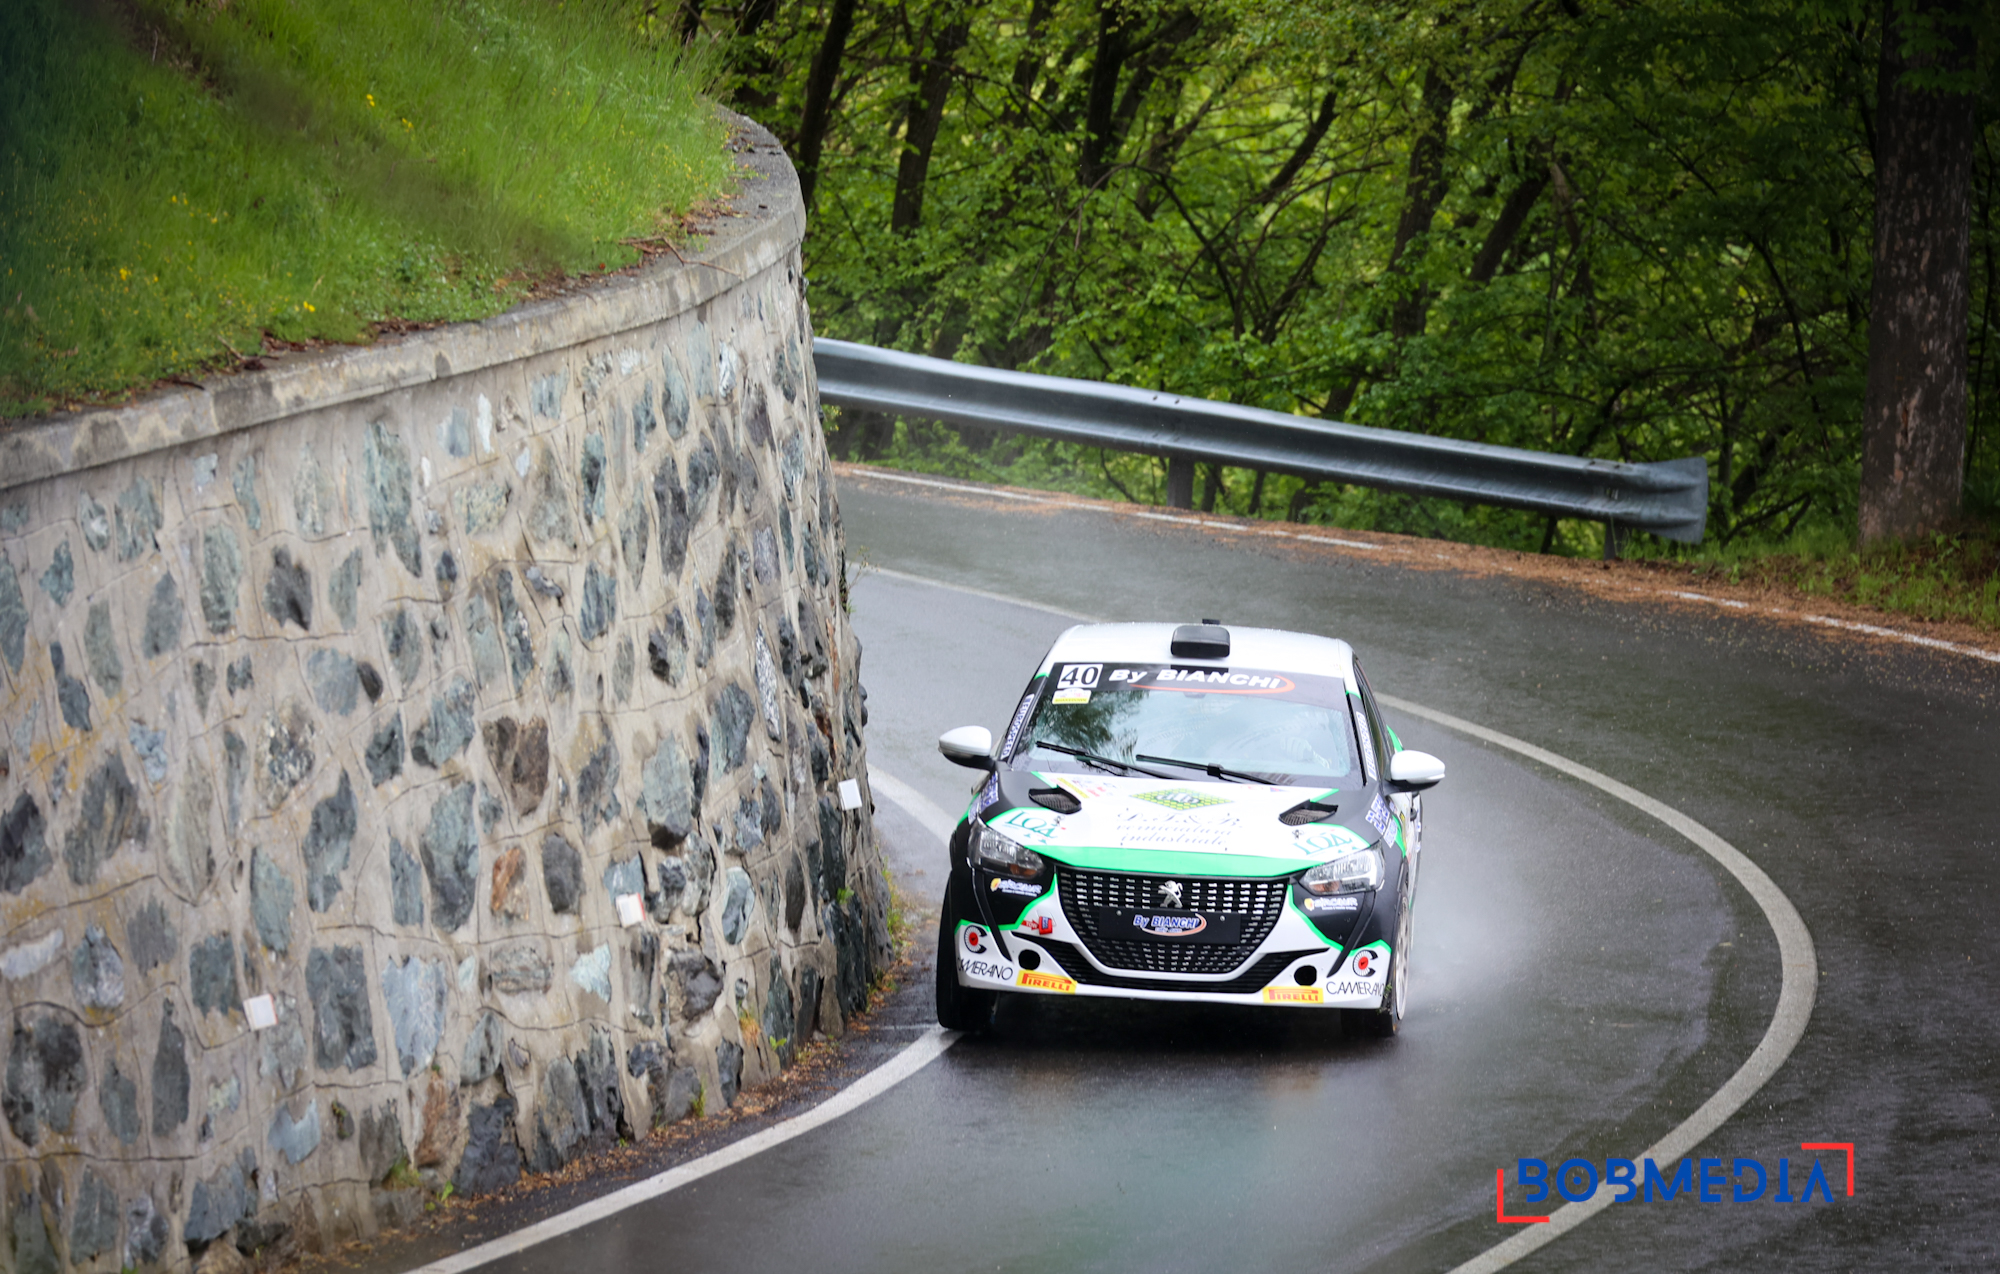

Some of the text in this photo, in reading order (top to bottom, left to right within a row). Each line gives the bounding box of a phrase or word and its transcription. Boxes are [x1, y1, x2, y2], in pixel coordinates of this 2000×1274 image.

[1061, 666, 1099, 686] 40
[1109, 669, 1280, 689] By BIANCHI
[1133, 914, 1200, 930] By BIANCHI
[1022, 972, 1072, 991] PIRELLI
[1269, 989, 1319, 1001] PIRELLI
